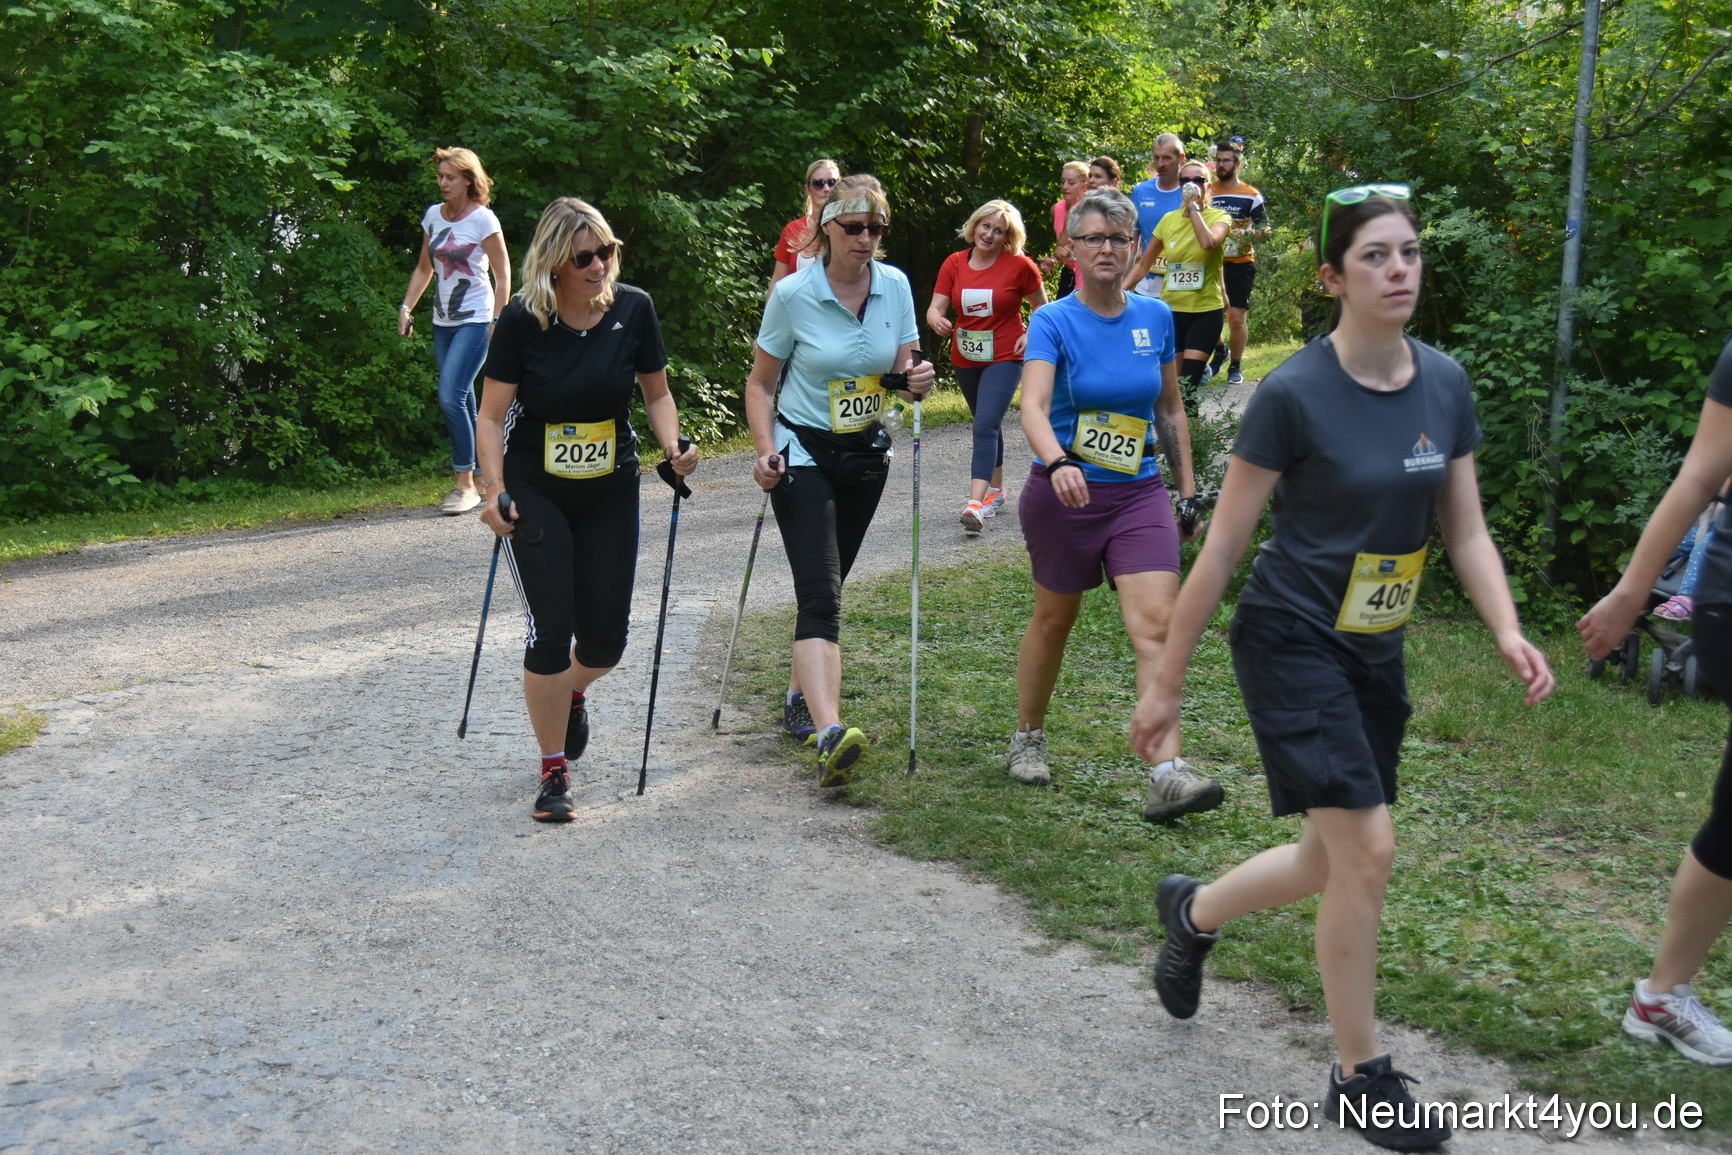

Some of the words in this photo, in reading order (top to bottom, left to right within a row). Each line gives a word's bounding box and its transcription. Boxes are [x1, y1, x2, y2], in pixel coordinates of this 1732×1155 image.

[1172, 272, 1199, 283] 1235
[962, 340, 984, 354] 534
[839, 393, 880, 418] 2020
[554, 441, 609, 463] 2024
[1082, 428, 1137, 458] 2025
[1094, 450, 1109, 459] Petra
[1109, 453, 1123, 462] Dietz
[1366, 579, 1413, 611] 406
